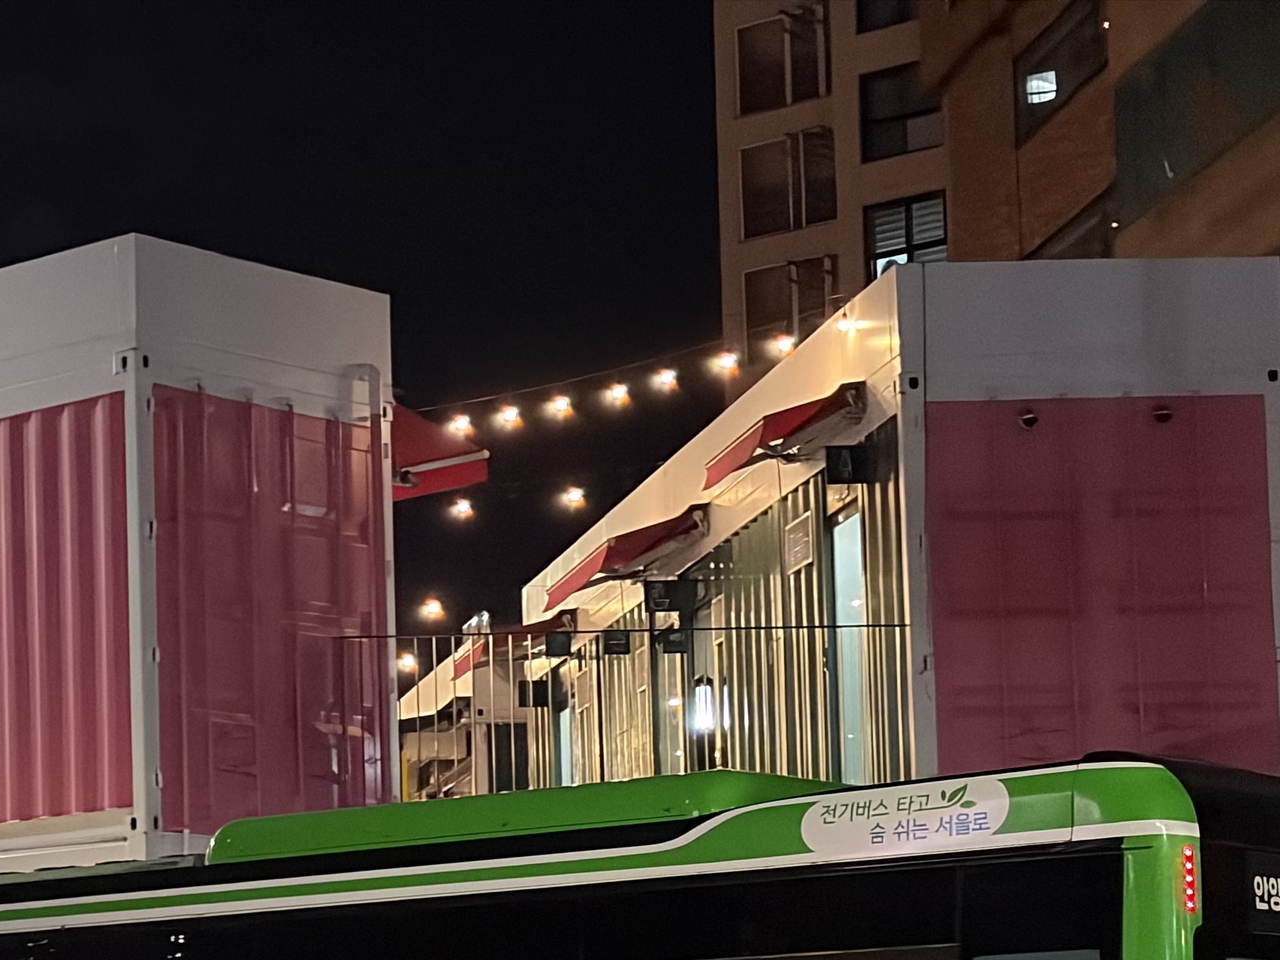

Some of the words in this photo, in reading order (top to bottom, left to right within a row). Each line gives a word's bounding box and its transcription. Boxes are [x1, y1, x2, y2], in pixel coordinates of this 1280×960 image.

[820, 799, 890, 824] 전기버스
[897, 794, 932, 815] 타고
[870, 822, 887, 844] 숨
[893, 818, 930, 842] 쉬는
[935, 811, 991, 837] 서울로
